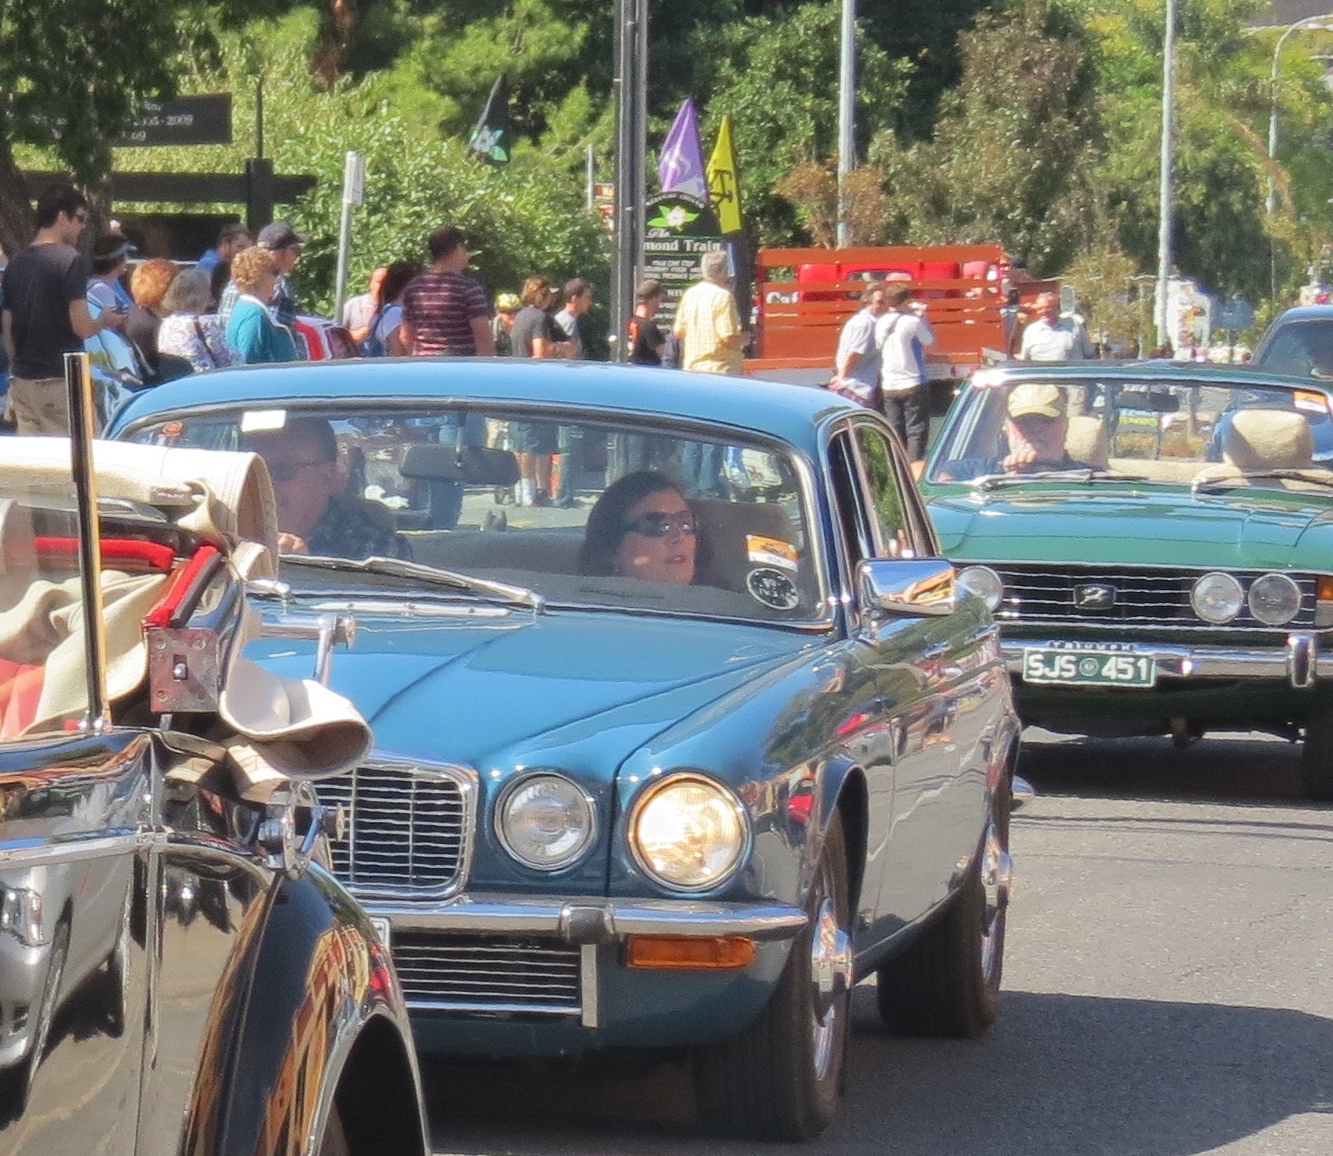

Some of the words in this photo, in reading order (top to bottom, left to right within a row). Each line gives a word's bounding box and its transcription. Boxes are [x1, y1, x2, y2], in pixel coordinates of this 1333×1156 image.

[643, 239, 679, 252] mond
[683, 239, 721, 252] Train
[1028, 653, 1078, 679] SJS
[1100, 655, 1148, 681] 451
